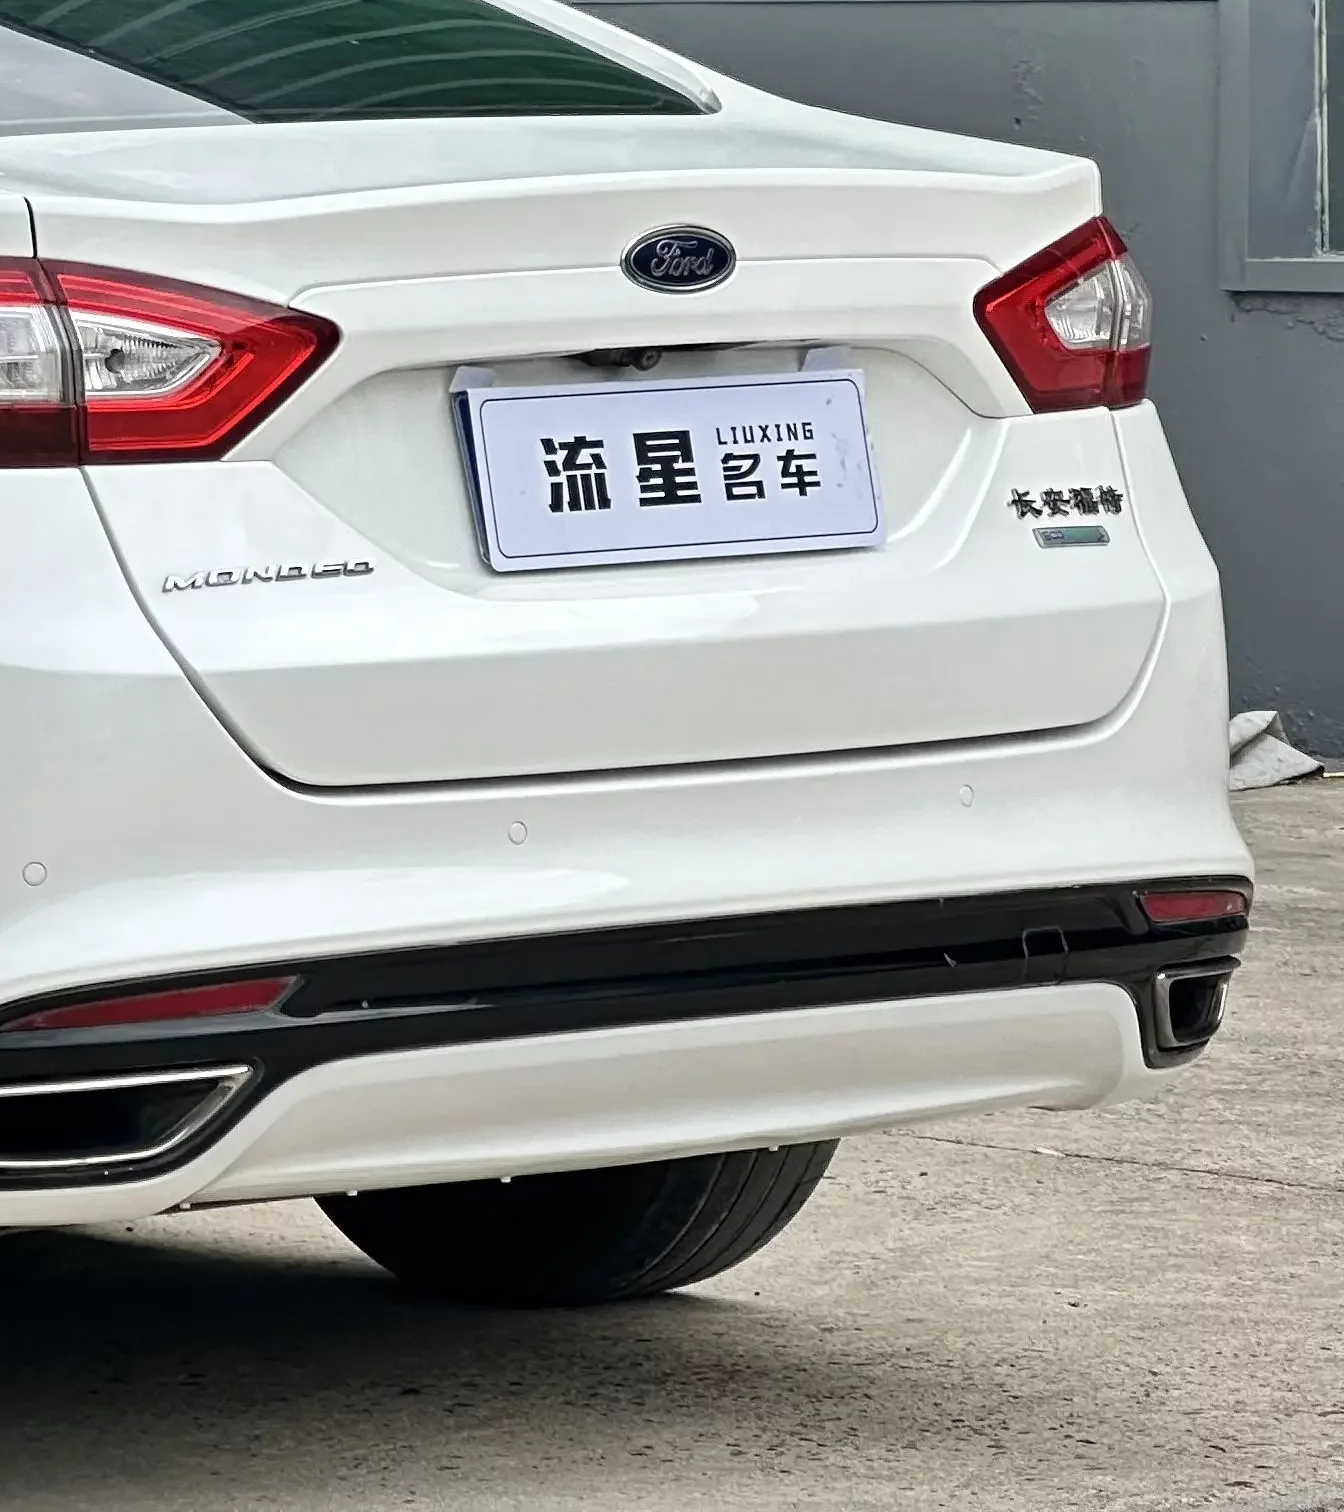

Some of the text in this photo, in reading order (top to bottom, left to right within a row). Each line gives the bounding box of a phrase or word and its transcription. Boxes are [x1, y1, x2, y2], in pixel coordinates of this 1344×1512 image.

[650, 239, 715, 277] Ford
[715, 421, 815, 446] LIUXING
[1007, 484, 1124, 520] 长安福特
[162, 558, 377, 593] MONDEO
